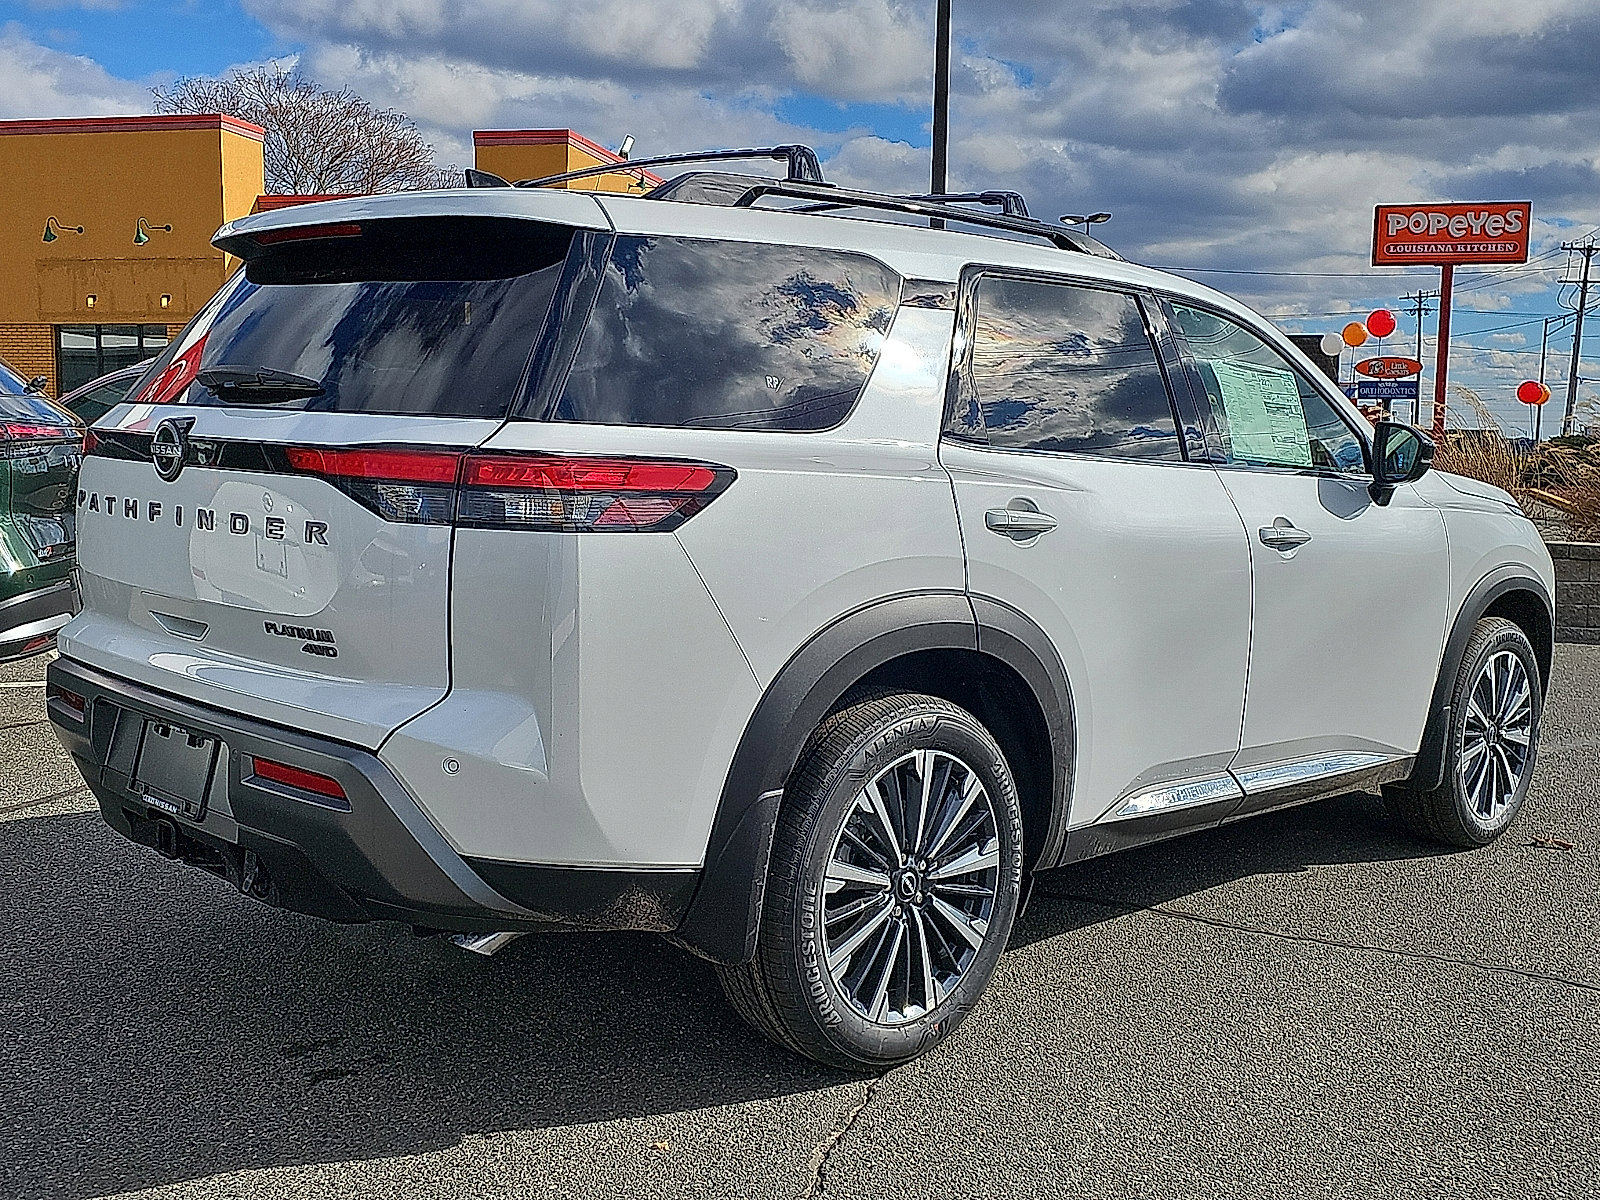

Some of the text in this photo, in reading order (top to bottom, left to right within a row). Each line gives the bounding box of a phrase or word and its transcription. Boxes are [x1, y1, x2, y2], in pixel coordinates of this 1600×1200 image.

[1389, 243, 1514, 253] LOUISIANA KITCHEN
[1385, 368, 1410, 376] Caesars
[1391, 362, 1408, 370] Little
[1360, 387, 1417, 395] ORTHODONTICS
[77, 489, 329, 546] PATHFINDER
[264, 621, 335, 643] PLATINUM
[301, 643, 338, 657] 4WD
[863, 717, 929, 764] ALENZA
[990, 759, 1022, 895] BRIDGESTONE
[802, 882, 843, 1029] BRIDGESTONE
